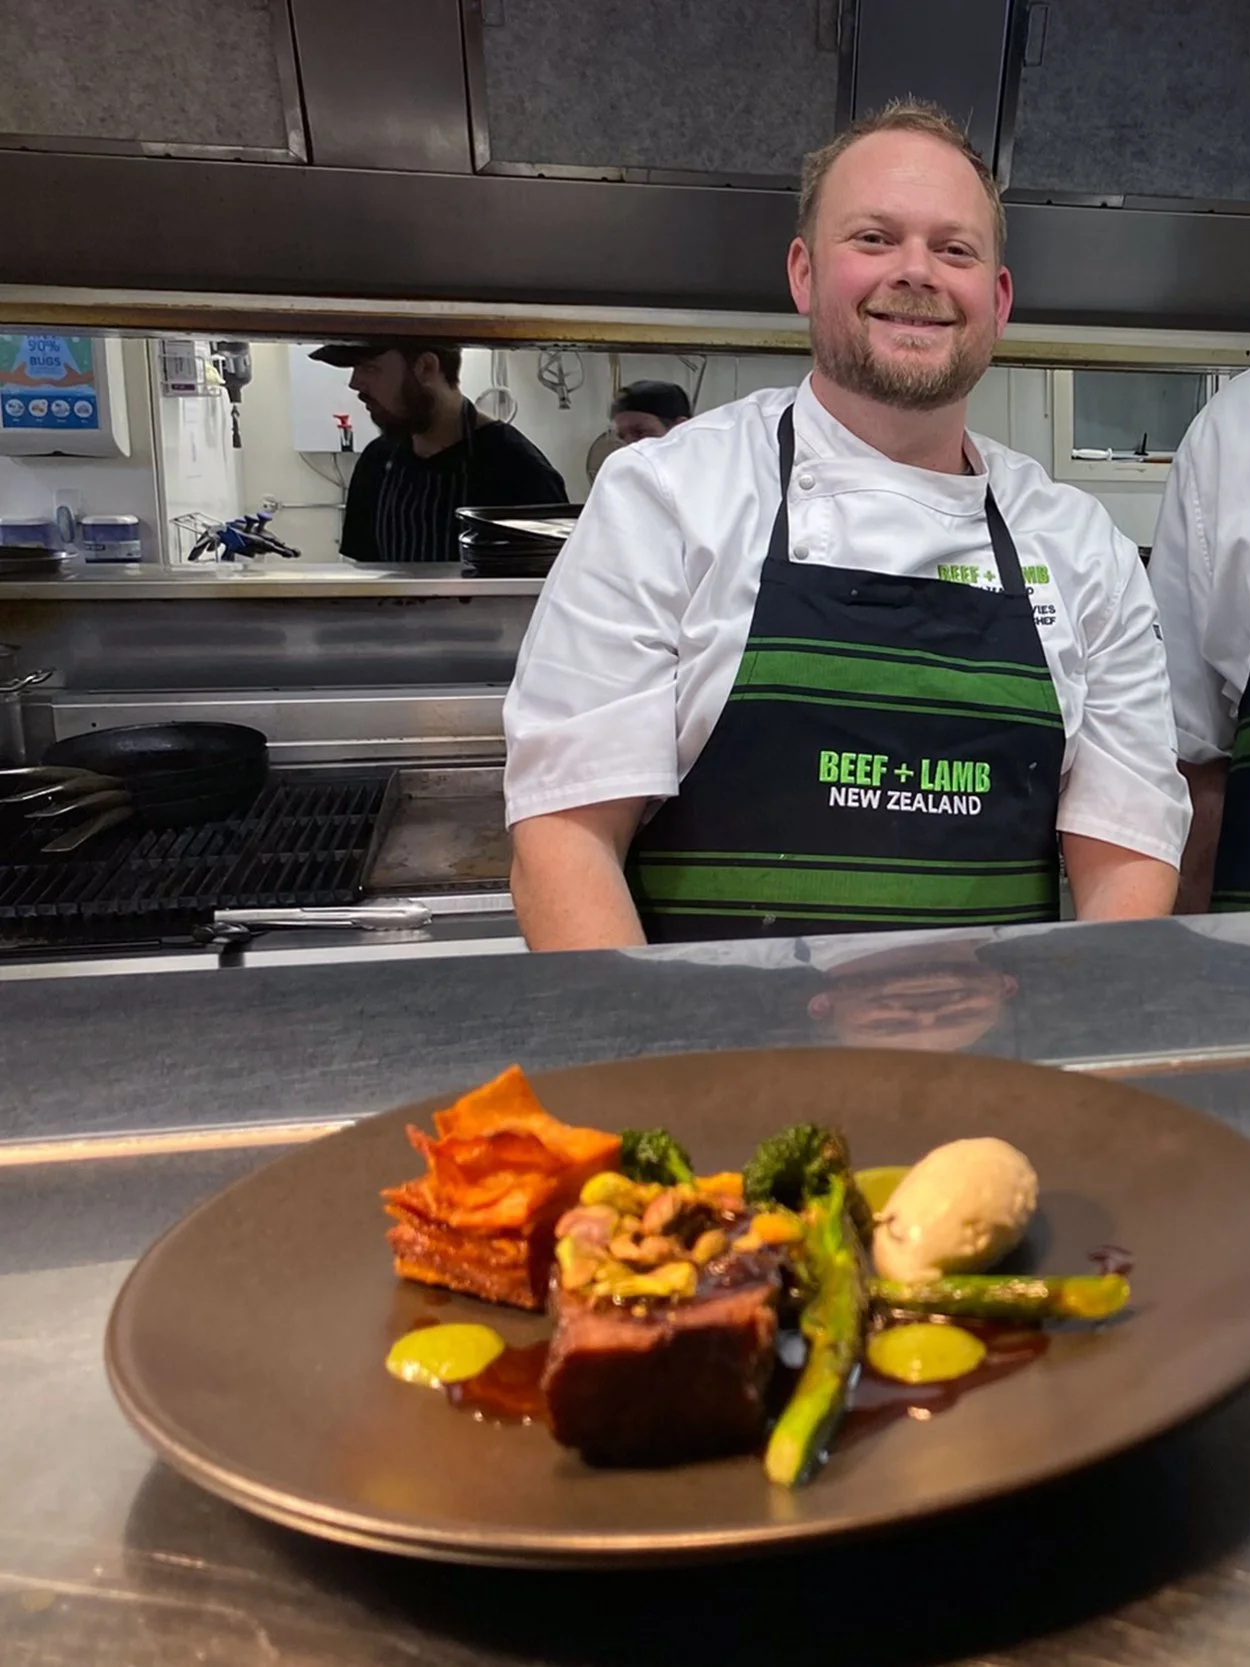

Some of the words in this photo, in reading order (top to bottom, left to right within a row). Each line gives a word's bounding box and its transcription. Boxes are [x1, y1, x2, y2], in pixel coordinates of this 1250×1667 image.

[28, 340, 60, 352] 90%
[29, 355, 61, 367] BUGS
[937, 564, 980, 584] BEEF
[983, 570, 996, 582] +
[1021, 564, 1050, 584] MB
[819, 750, 889, 787] BEEF
[894, 763, 914, 783] +
[920, 758, 991, 793] LAMB
[829, 786, 882, 809] NEW
[886, 790, 982, 815] ZEALAND
